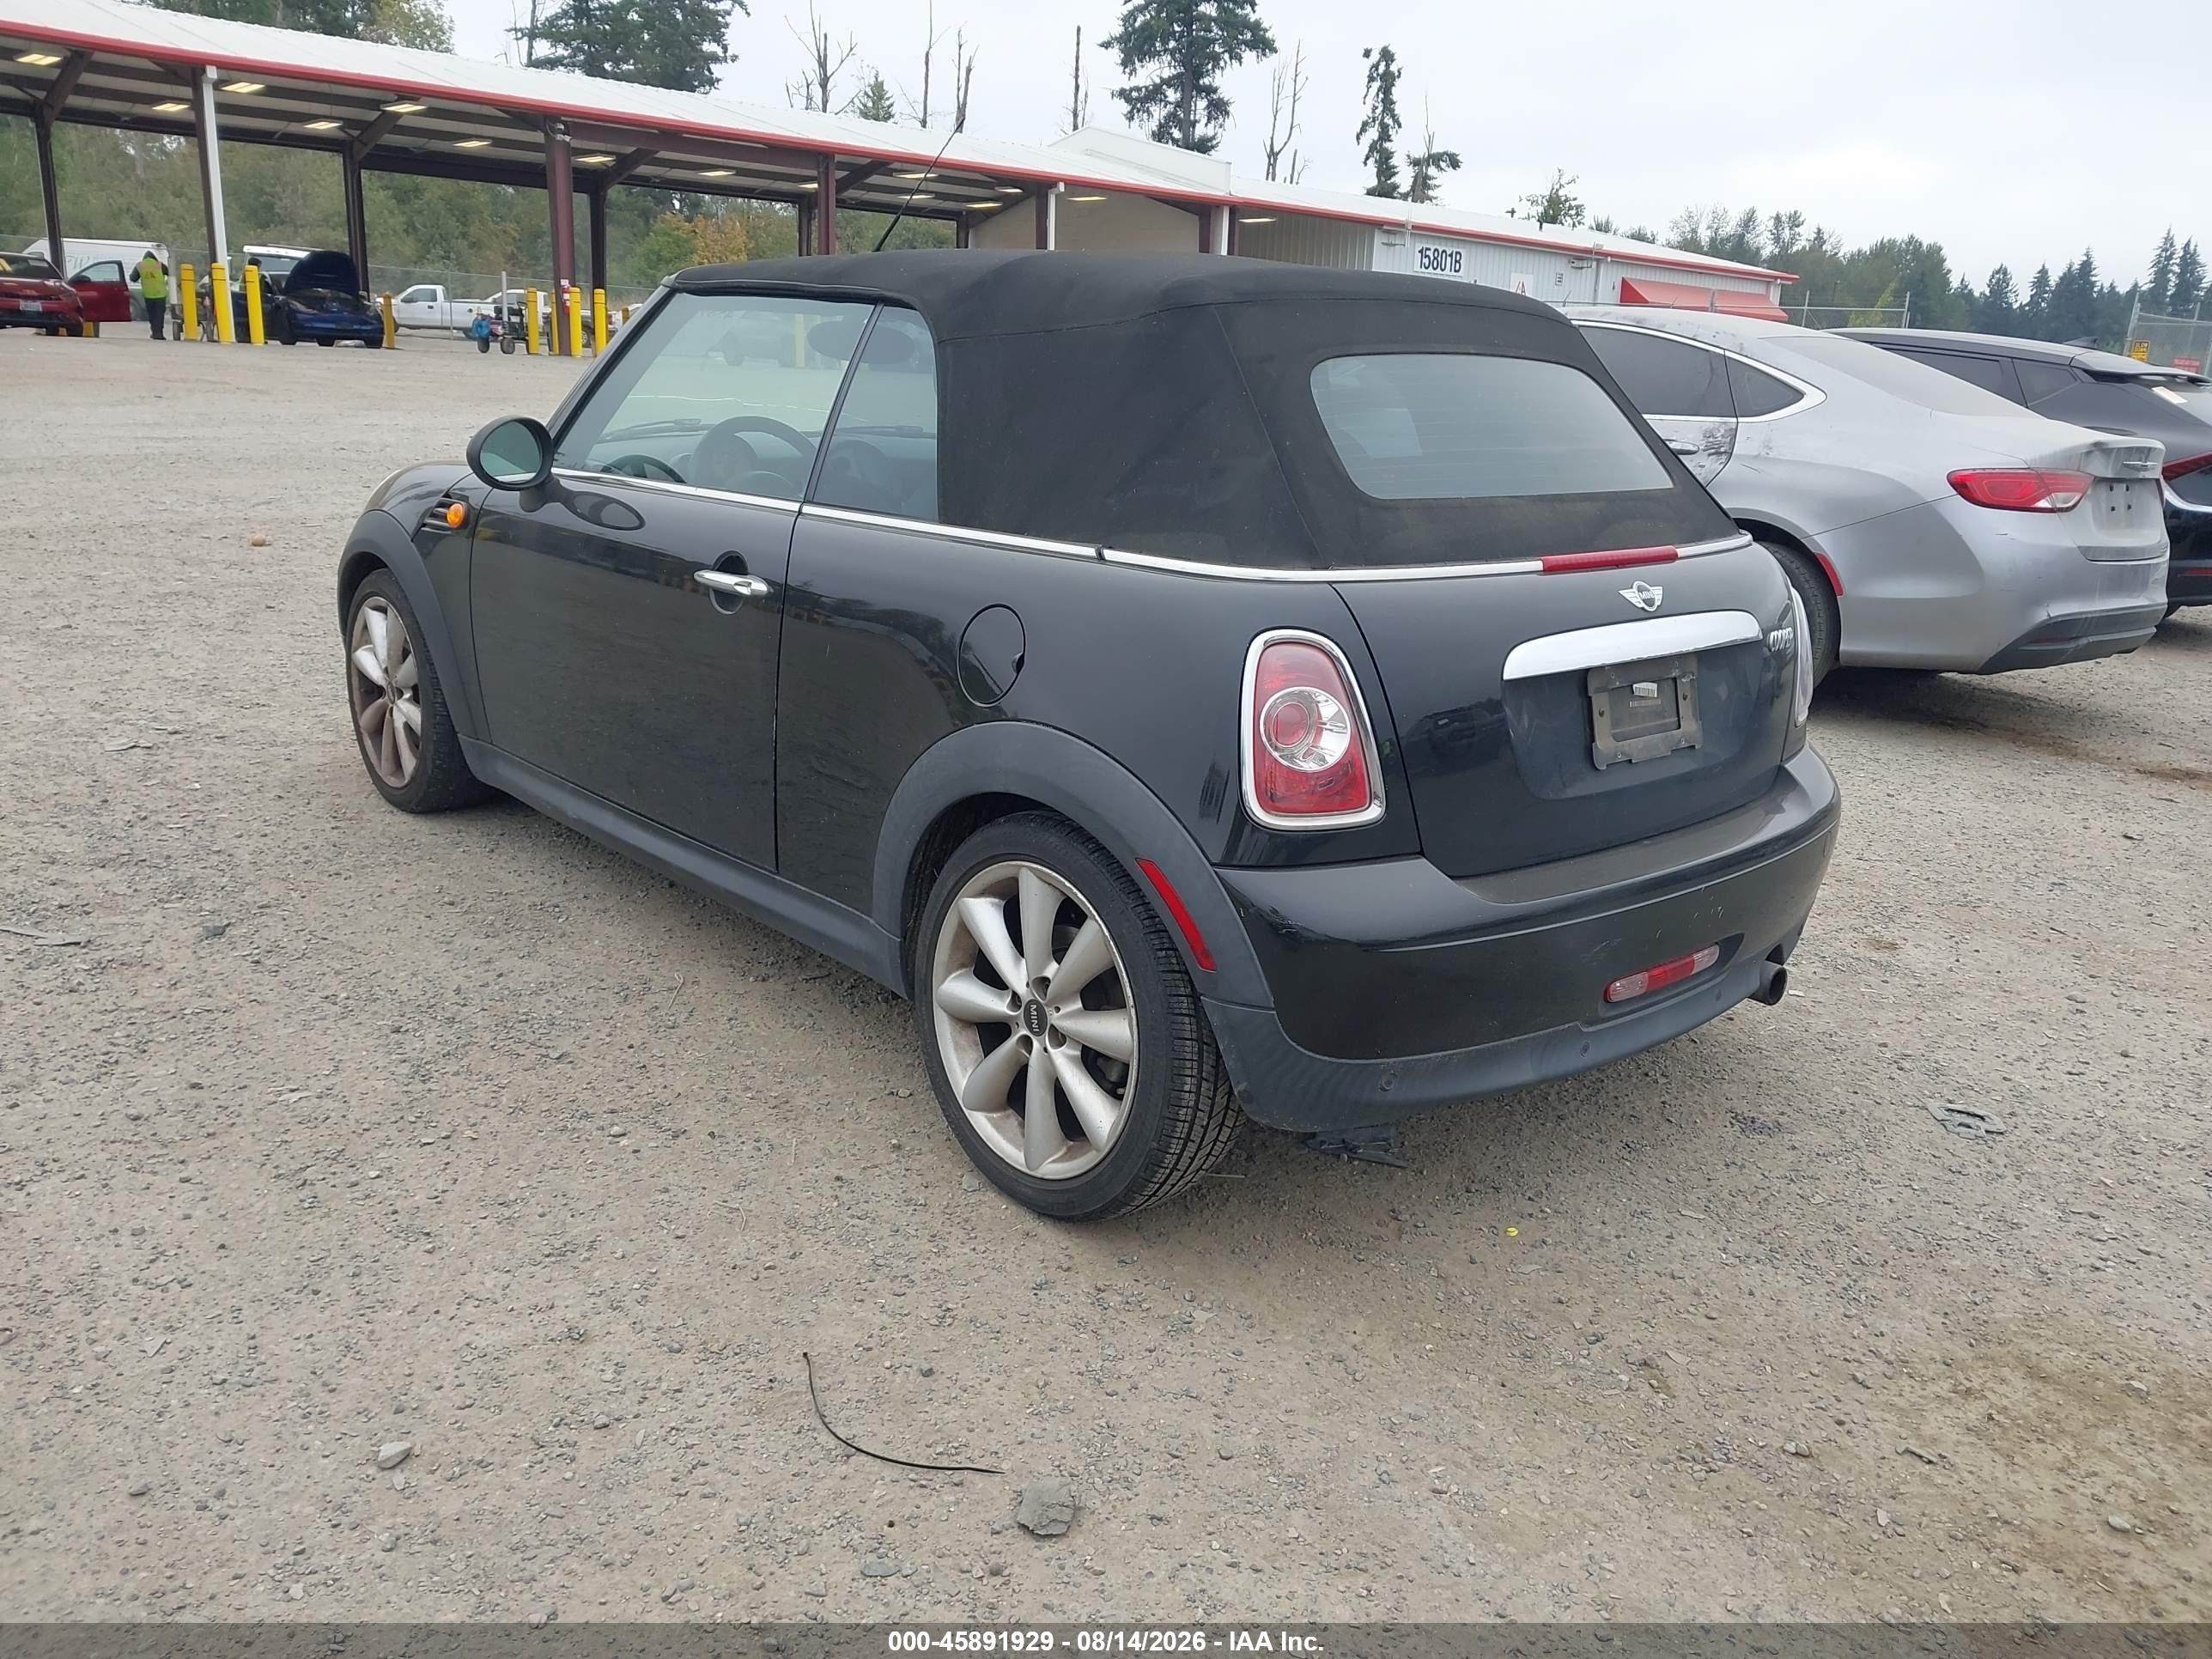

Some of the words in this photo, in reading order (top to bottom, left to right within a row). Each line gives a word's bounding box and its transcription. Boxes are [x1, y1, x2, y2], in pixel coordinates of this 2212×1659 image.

[1418, 246, 1462, 273] 15801B
[1638, 591, 1656, 599] MINI
[1030, 1004, 1040, 1032] MINI
